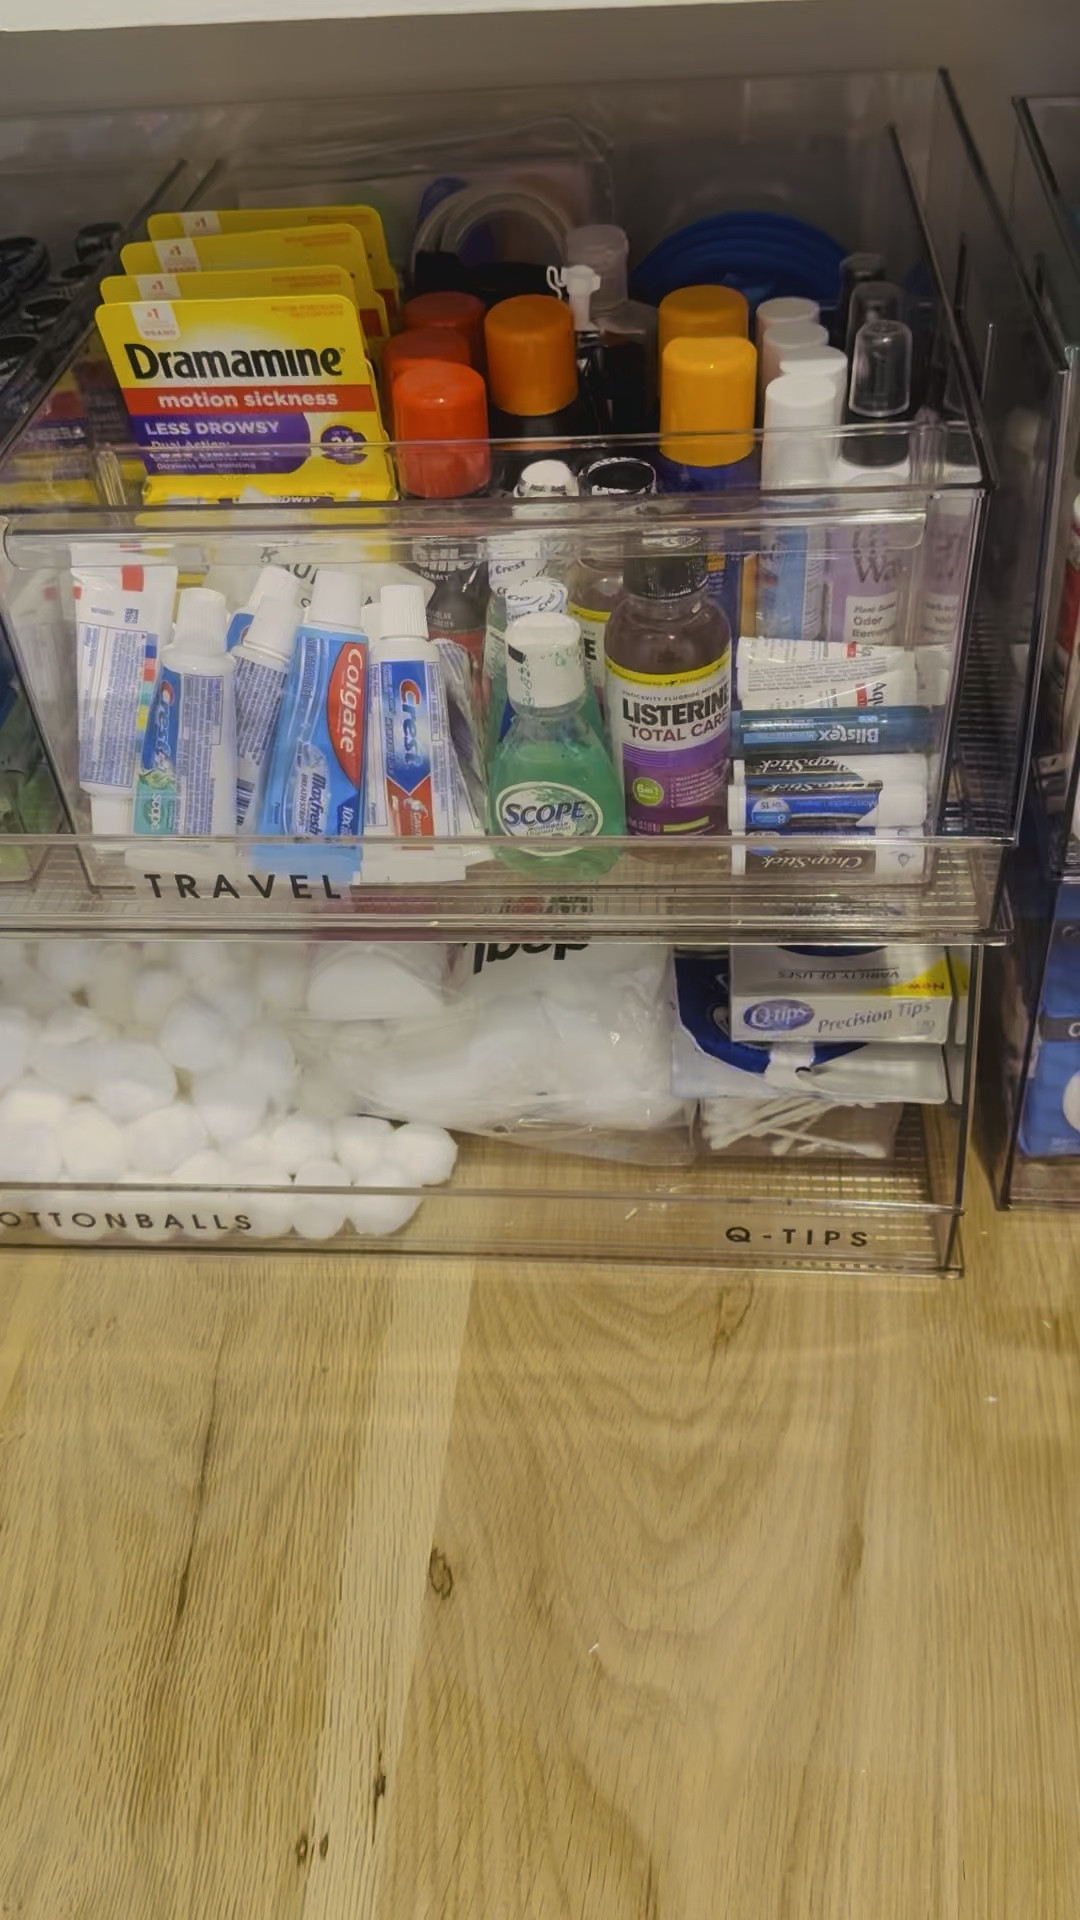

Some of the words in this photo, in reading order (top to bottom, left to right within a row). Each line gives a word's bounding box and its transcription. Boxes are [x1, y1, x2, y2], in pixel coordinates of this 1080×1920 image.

[124, 343, 343, 380] Dramamine
[158, 391, 238, 408] motion
[244, 390, 338, 407] sickness
[145, 422, 191, 436] LESS
[195, 421, 279, 435] DROWSY
[339, 648, 364, 753] Colgate
[622, 684, 730, 727] LISTERINE
[400, 679, 422, 766] Crest
[628, 723, 687, 743] TOTAL
[691, 707, 728, 738] CARE
[816, 724, 880, 745] Blistex
[760, 757, 848, 773] hapStick
[503, 799, 587, 826] SCOPE
[761, 852, 863, 871] ChapStick
[144, 873, 343, 900] TRAVEL
[750, 1003, 813, 1028] Q-tips
[818, 1008, 893, 1034] Precision
[898, 1001, 932, 1018] Tips
[726, 1226, 869, 1248] Q-TIPS
